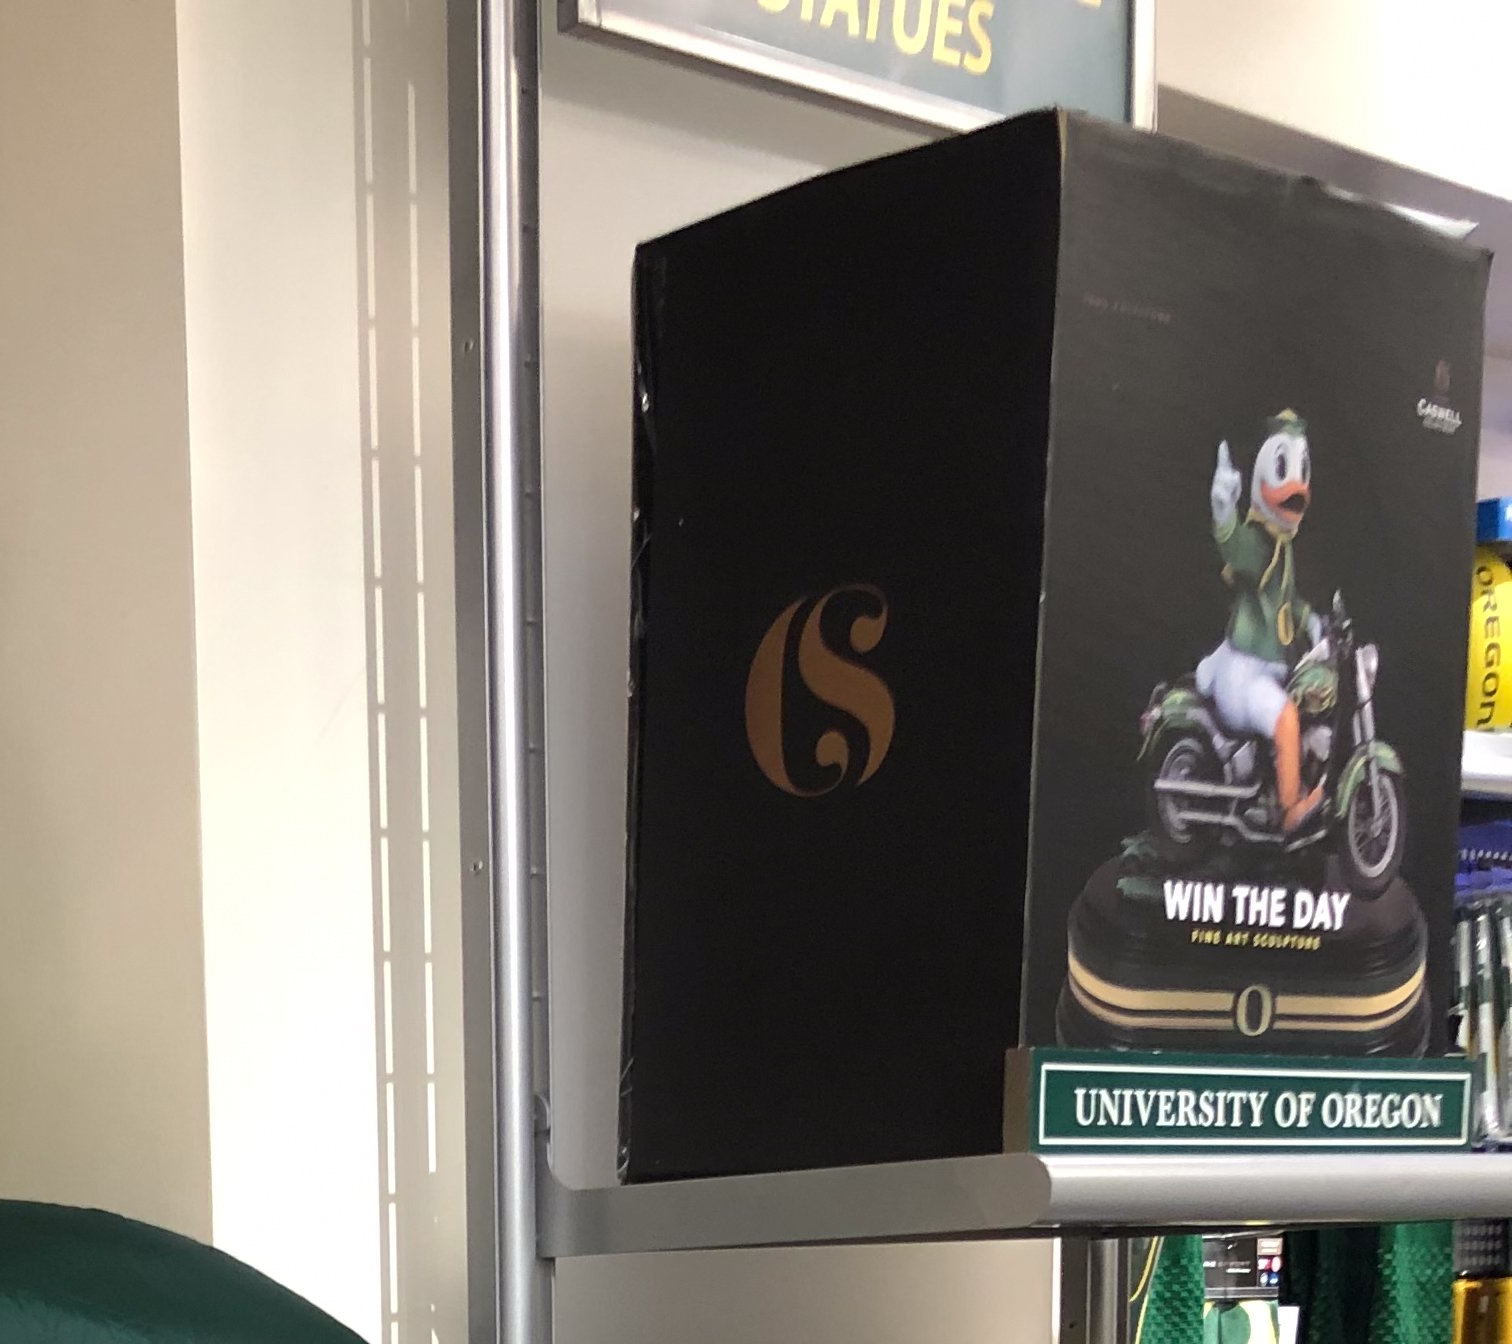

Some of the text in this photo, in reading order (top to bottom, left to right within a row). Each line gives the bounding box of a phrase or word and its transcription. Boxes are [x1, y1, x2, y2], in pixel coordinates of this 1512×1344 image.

[1476, 566, 1501, 731] OREGON
[1163, 879, 1351, 931] WIN THE DAY
[1191, 929, 1322, 951] FINE ART SCULPTURE
[1074, 1087, 1444, 1129] UNIVERSITY OF OREGON
